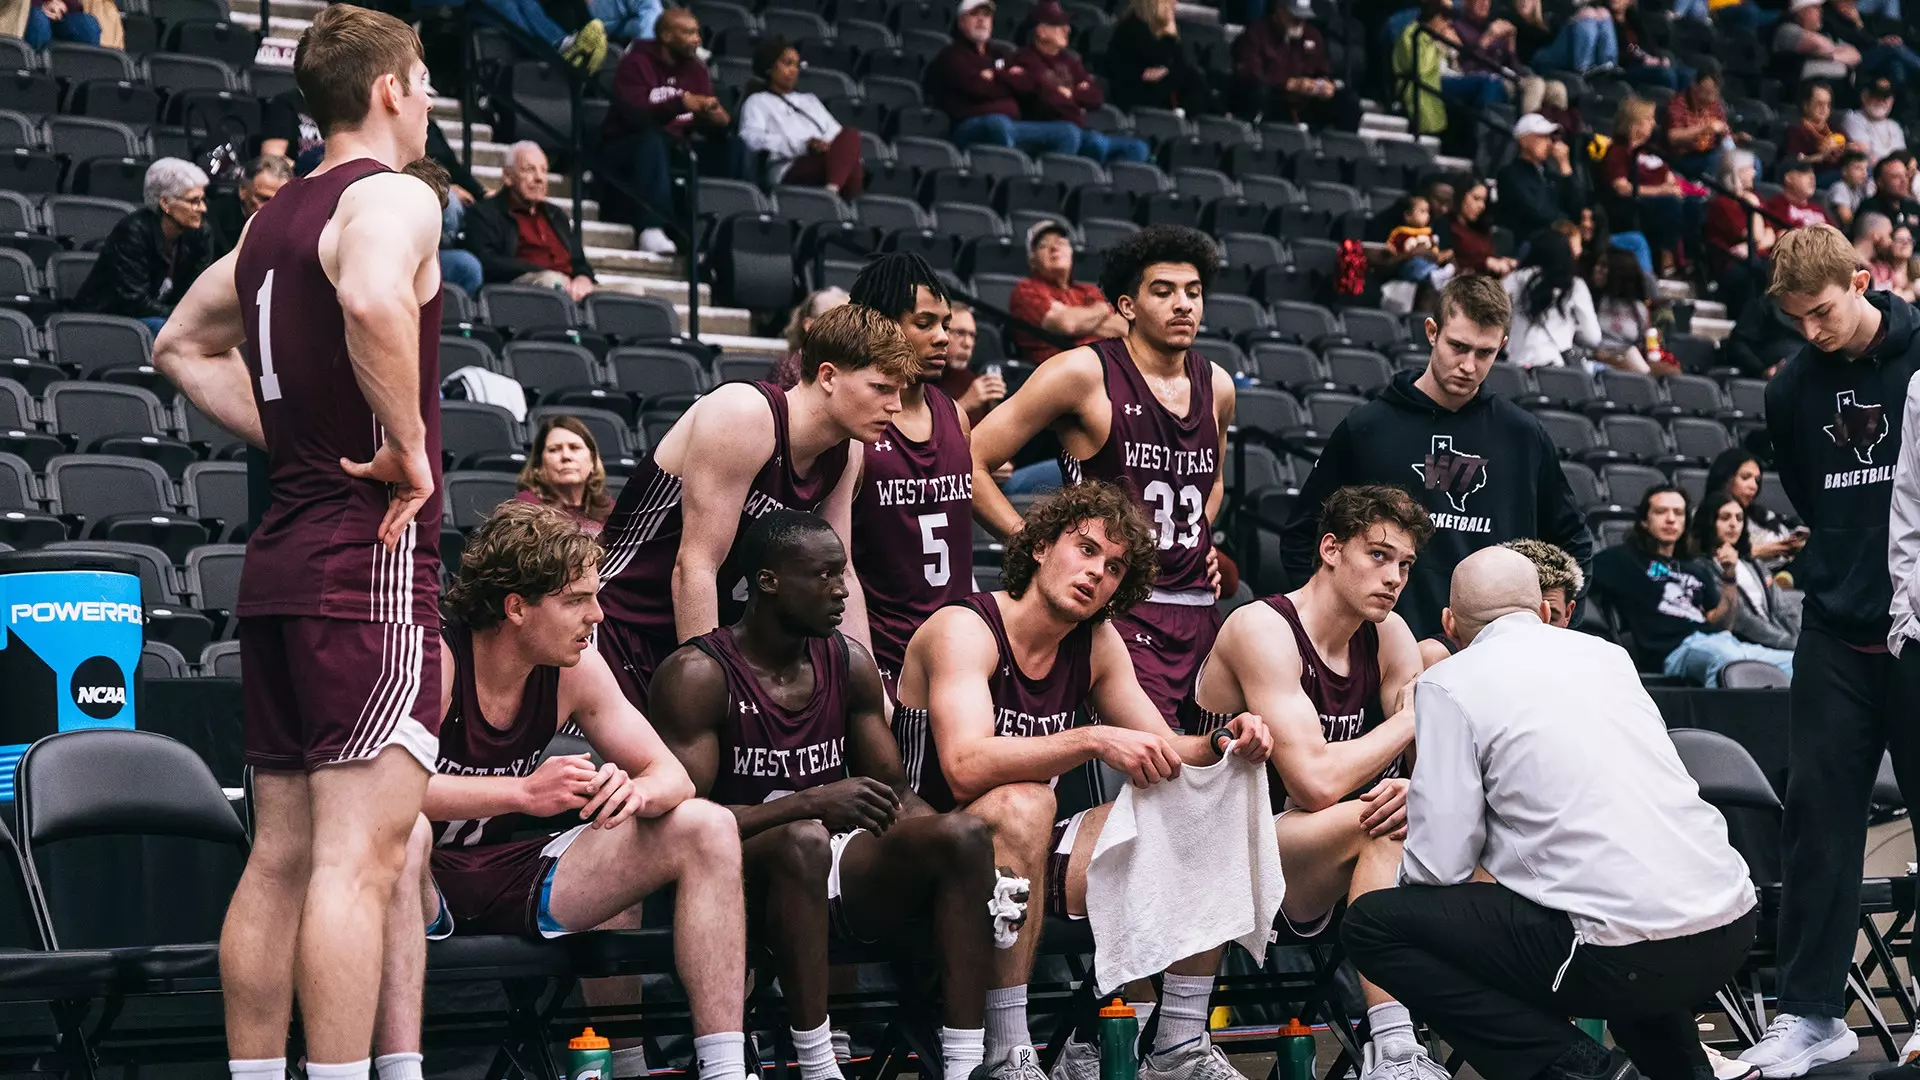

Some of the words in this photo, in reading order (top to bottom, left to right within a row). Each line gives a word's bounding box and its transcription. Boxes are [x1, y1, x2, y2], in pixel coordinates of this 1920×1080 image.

[256, 269, 282, 402] 1
[1124, 441, 1170, 471] WEST
[876, 479, 927, 506] WEST
[929, 473, 973, 503] TEXAS
[1424, 454, 1489, 492] WT
[1143, 480, 1204, 550] 33
[1428, 512, 1492, 533] SKETBALL
[918, 512, 951, 587] 5
[77, 686, 127, 704] NCAA
[733, 746, 790, 778] WEST
